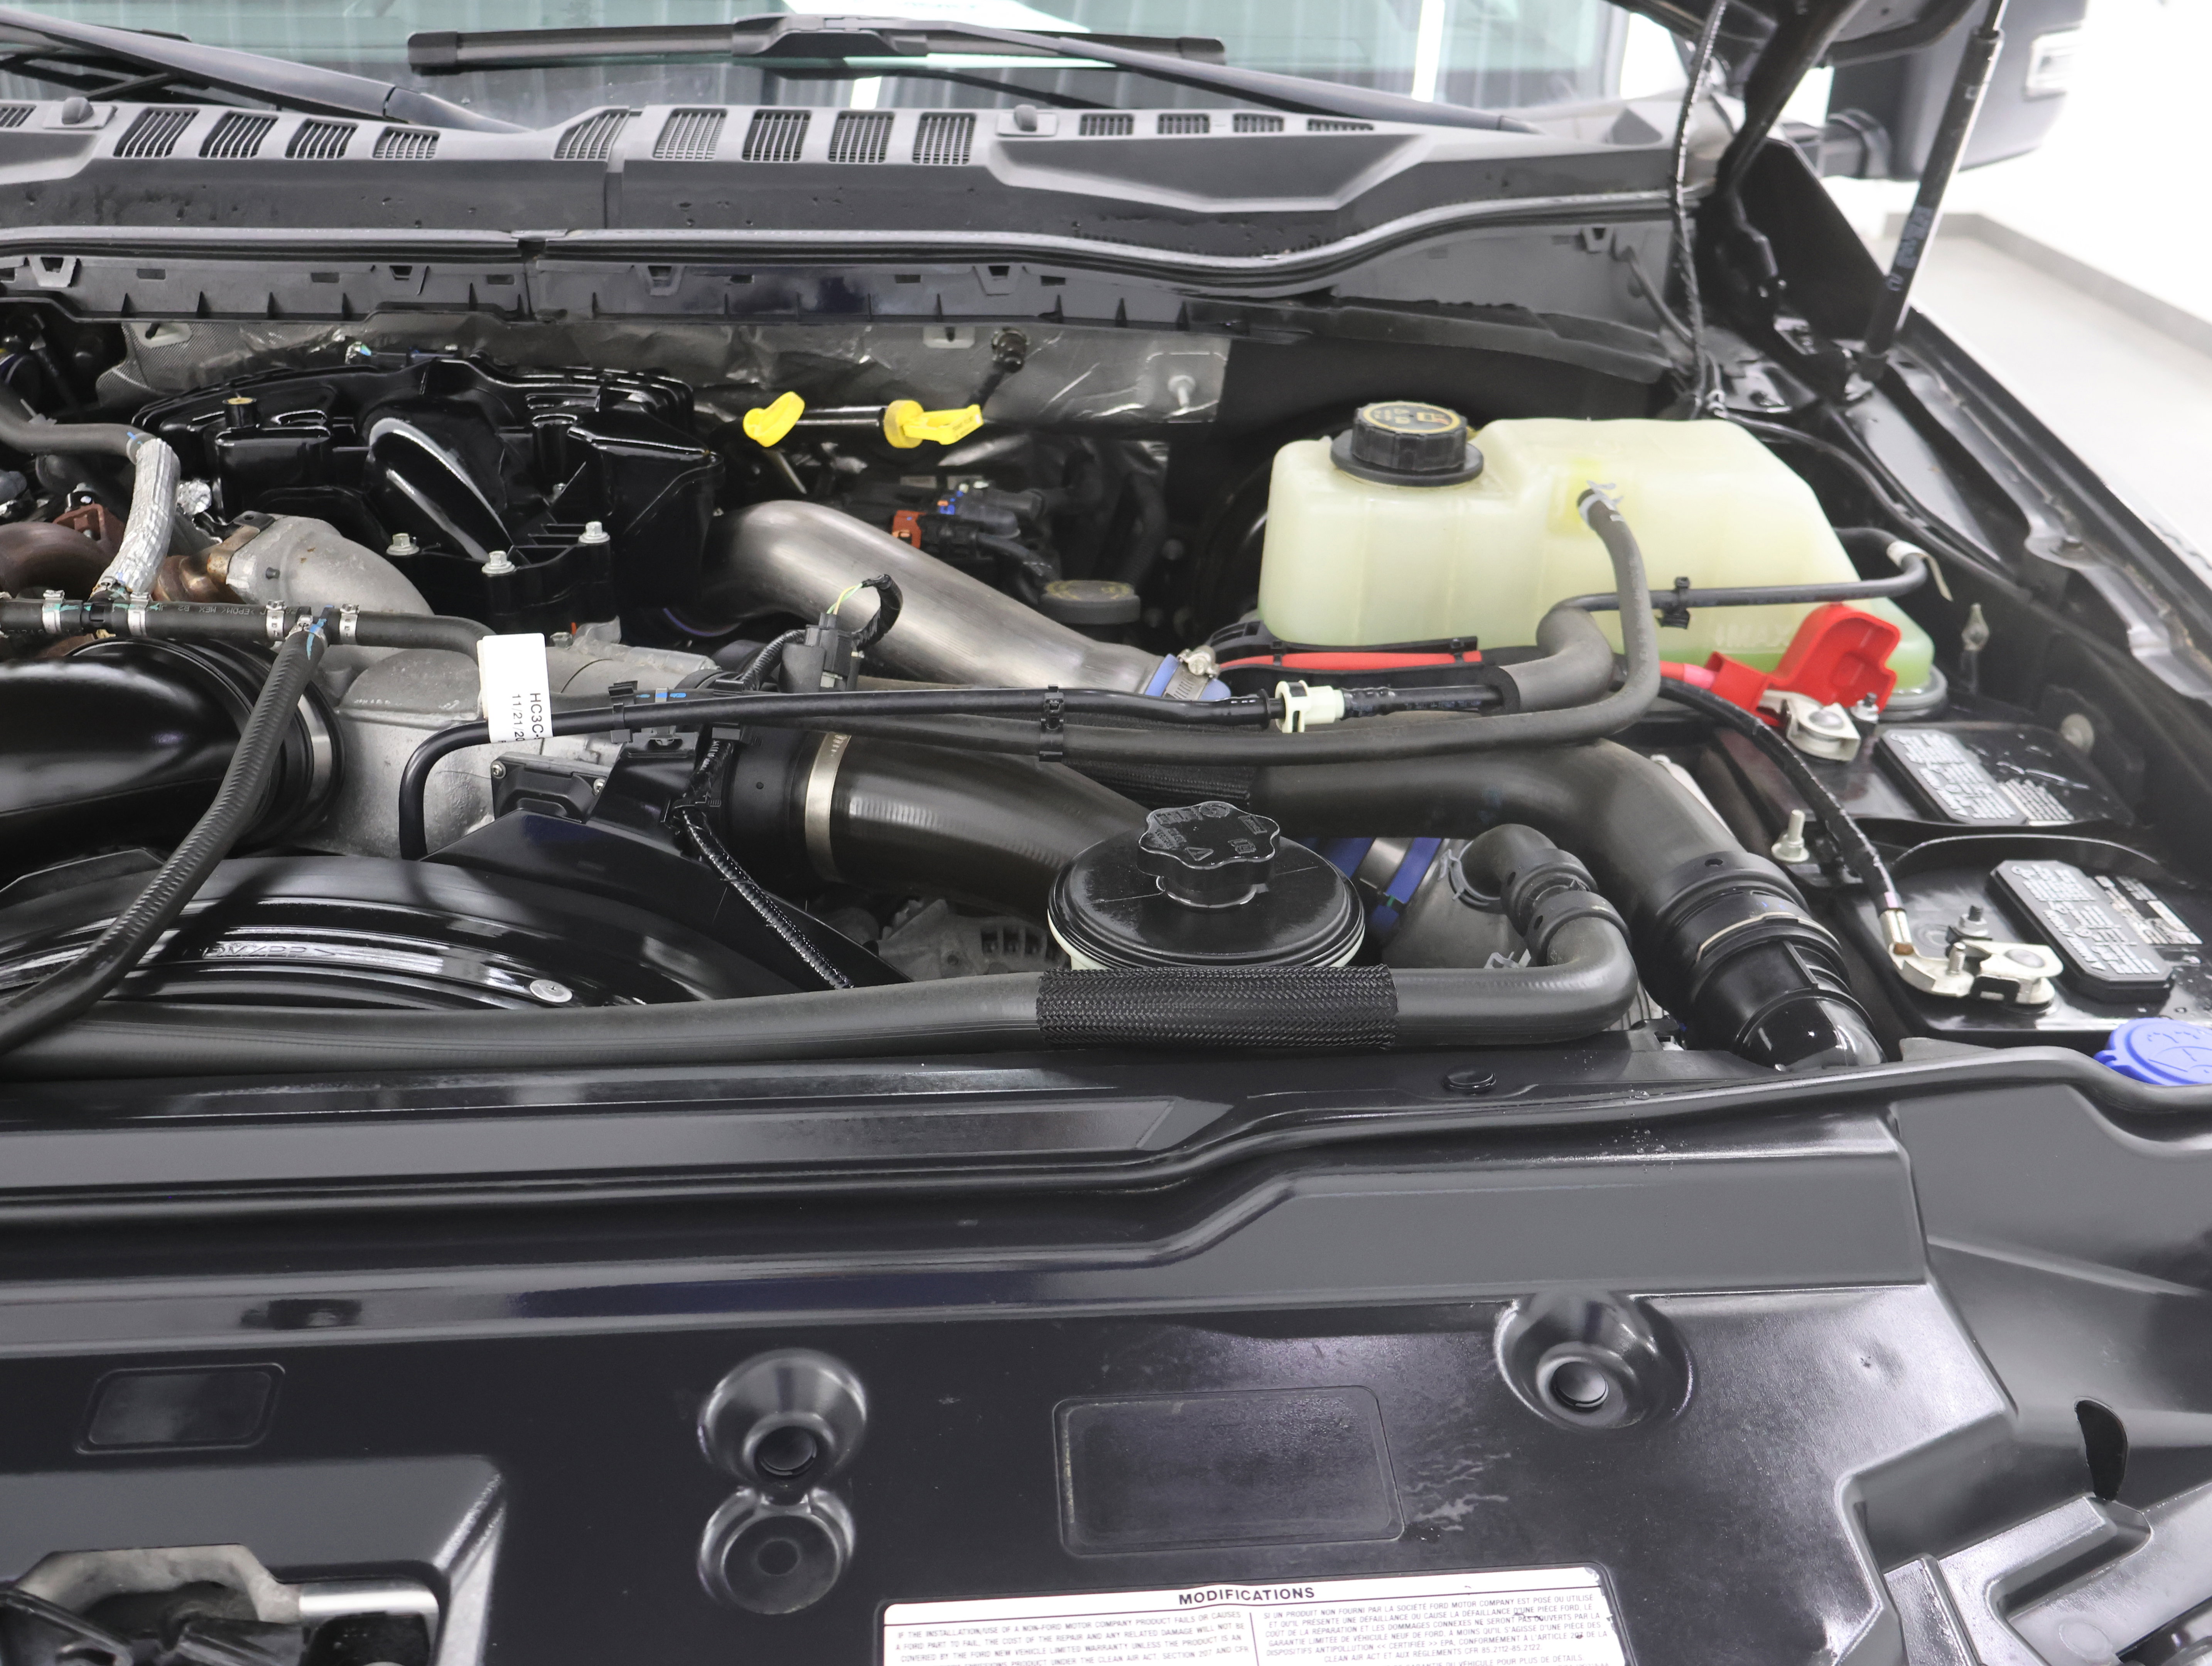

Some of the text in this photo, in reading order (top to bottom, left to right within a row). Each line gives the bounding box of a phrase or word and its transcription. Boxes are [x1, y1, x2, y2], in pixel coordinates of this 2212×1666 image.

[1179, 1587, 1315, 1605] MODIFICATIONS
[1286, 1610, 1318, 1618] PRODUIT
[1479, 1599, 1514, 1607] COMPANY
[1424, 1611, 1447, 1619] CAUSE
[1022, 1623, 1062, 1632] NON-FORD
[1065, 1622, 1092, 1630] MOTOR
[1095, 1620, 1132, 1628] COMPANY
[1136, 1617, 1171, 1626] PRODUCT
[1174, 1615, 1196, 1624] FAILS
[1211, 1610, 1241, 1620] CAUSES
[1388, 1622, 1430, 1631] DOMMAGES
[1433, 1619, 1472, 1628] CONNEXES
[1486, 1616, 1515, 1625] SERONT
[1056, 1634, 1083, 1642] REPAIR
[1124, 1629, 1158, 1638] RELATED
[1161, 1627, 1193, 1636] DAMAGE
[1269, 1638, 1305, 1647] GARANTIE
[901, 1654, 936, 1663] COVERED
[1015, 1647, 1046, 1656] VEHICLE
[1050, 1646, 1081, 1654] LIMITED
[1085, 1643, 1128, 1652] WARRANTY
[1132, 1641, 1161, 1649] UNLESS
[1182, 1636, 1217, 1647] PRODUCT
